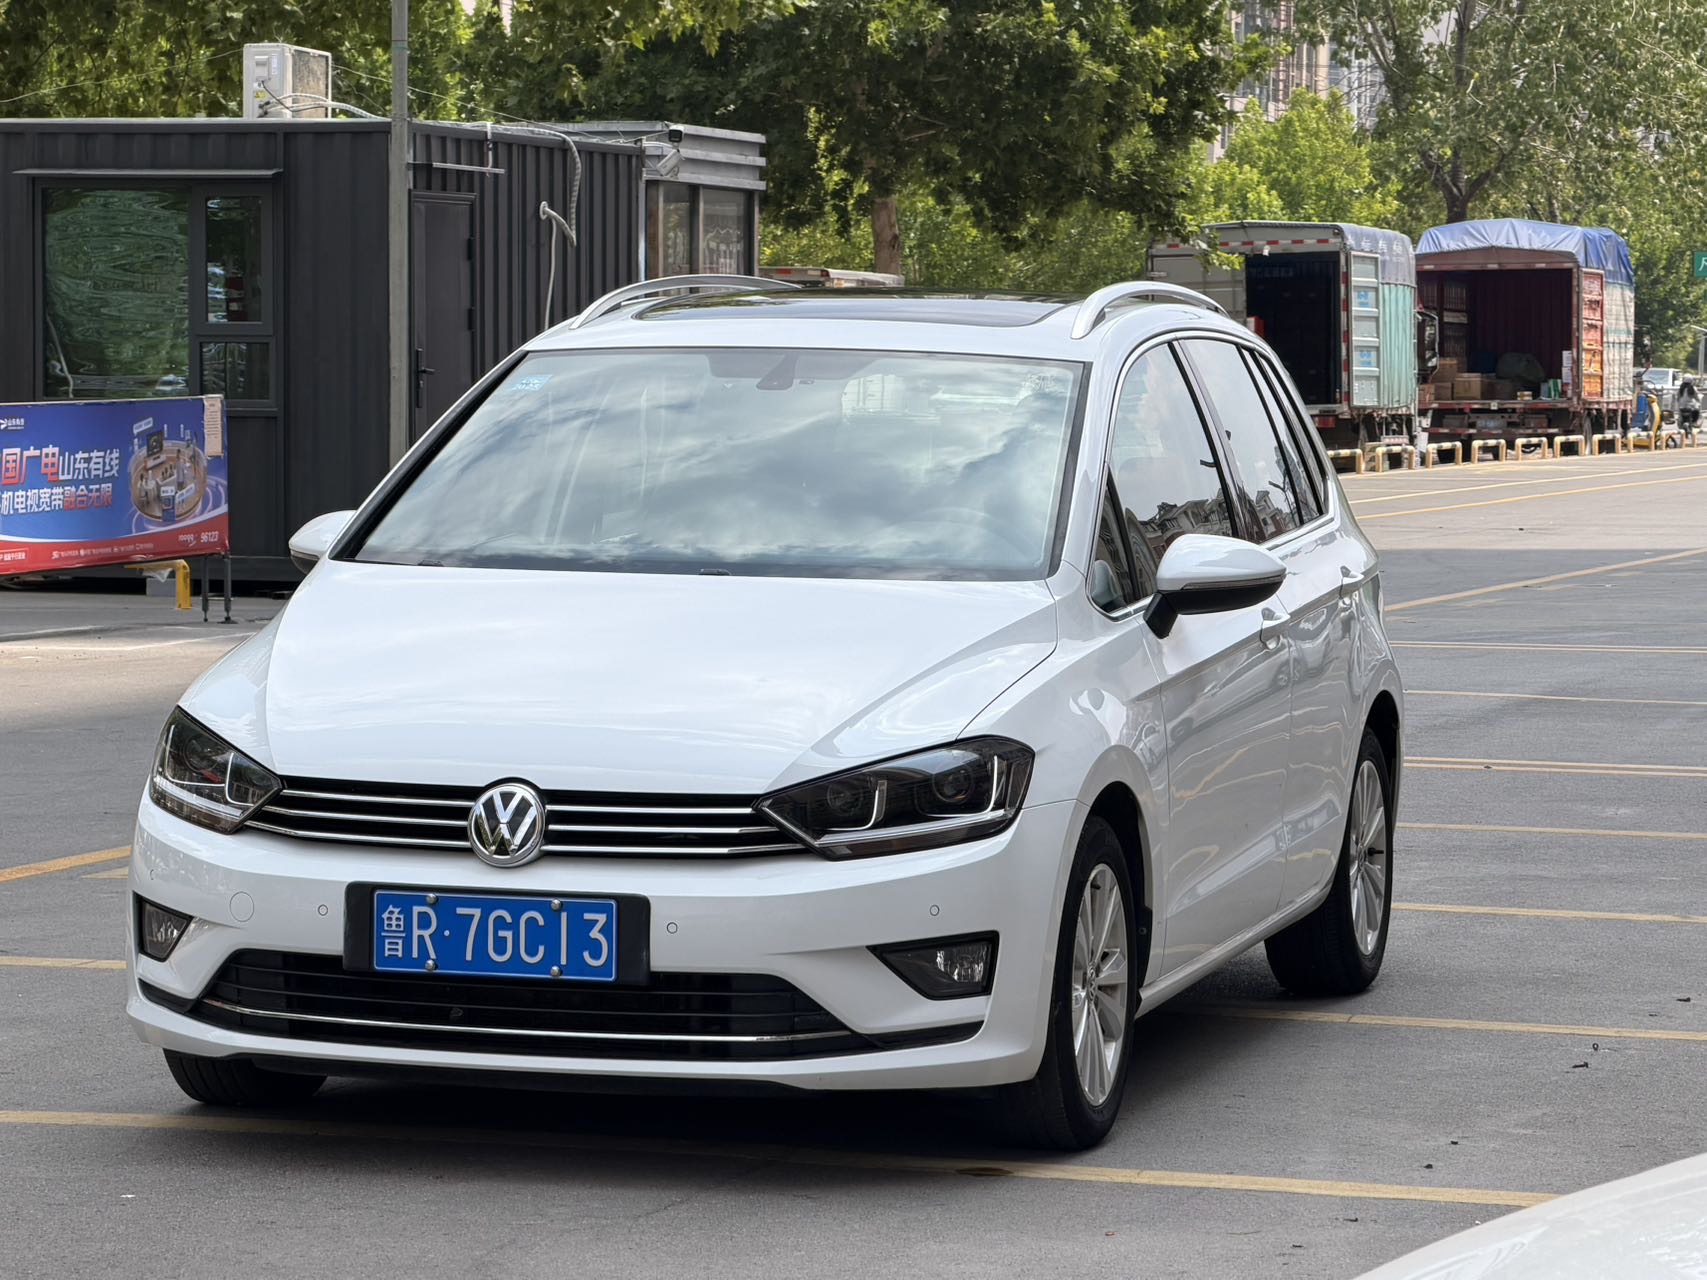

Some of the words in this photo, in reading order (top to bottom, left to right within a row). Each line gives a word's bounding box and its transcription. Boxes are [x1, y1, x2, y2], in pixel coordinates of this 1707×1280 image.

[0, 444, 120, 485] 国广电山东有线
[0, 483, 113, 515] 机电视宽带融合无限
